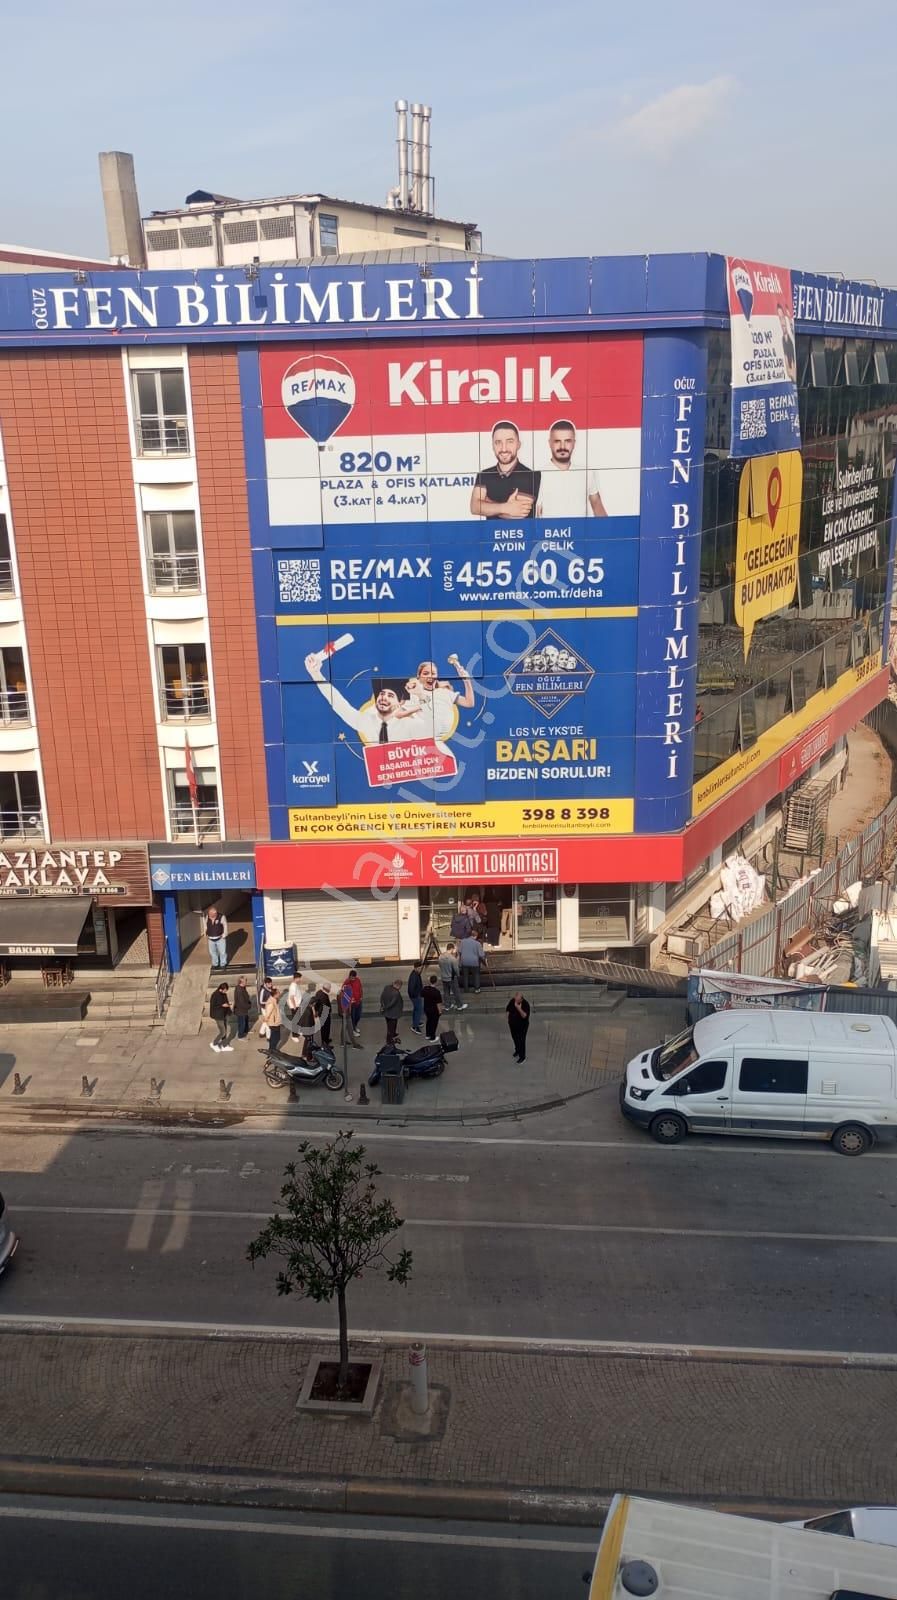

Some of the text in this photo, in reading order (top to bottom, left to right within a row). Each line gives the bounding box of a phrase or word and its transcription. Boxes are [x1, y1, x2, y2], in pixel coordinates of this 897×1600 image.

[48, 267, 485, 329] FEN BİLİMLERİ
[797, 283, 885, 327] FEN BİLİMLERİ
[31, 288, 48, 330] OĞUZ
[743, 361, 762, 372] OFIS
[291, 379, 346, 396] RE/MAX
[388, 356, 573, 406] Kiralık
[673, 376, 696, 391] OĞUZ
[770, 409, 790, 423] DEHA
[339, 451, 392, 473] 820
[320, 476, 475, 490] PLAZA & OFIS KATLARI
[333, 493, 427, 508] (3.KAT & 4.KAT)
[494, 529, 524, 540] ENES
[544, 526, 571, 539] BAKİ
[823, 521, 834, 542] EN
[492, 541, 526, 552] AYDIN
[541, 540, 575, 553] ÇELİK
[330, 557, 432, 580] RE/MAX
[443, 560, 455, 592] (0216)
[456, 557, 605, 588] 455 60 65
[331, 581, 395, 601] DEHA
[663, 394, 693, 780] FEN BİLİMLERİ
[741, 563, 796, 606] BU DURAKTA!
[459, 586, 604, 602] www.remax.com.tr/deha
[537, 674, 561, 682] OĞUZ
[515, 680, 584, 692] FEN BİLİMLERİ
[509, 727, 530, 737] LGS
[532, 726, 546, 736] VE
[387, 744, 428, 761] BÜYÜK
[496, 738, 598, 764] BAŞARI
[292, 773, 330, 785] karayel
[541, 765, 612, 779] SORULUR!
[293, 812, 366, 823] Sultanbeyli'nin
[368, 811, 388, 820] Lise
[403, 810, 473, 819] Üniversitelere
[522, 808, 610, 820] 398 8 398
[294, 820, 496, 834] EN ÇOK ÖĞRENCİ YERLEŞTİREN KURSU
[451, 852, 553, 873] KENT LOKANTASI
[170, 870, 251, 882] FEN BİLİMLERİ
[8, 947, 55, 955] BAKLAVA
